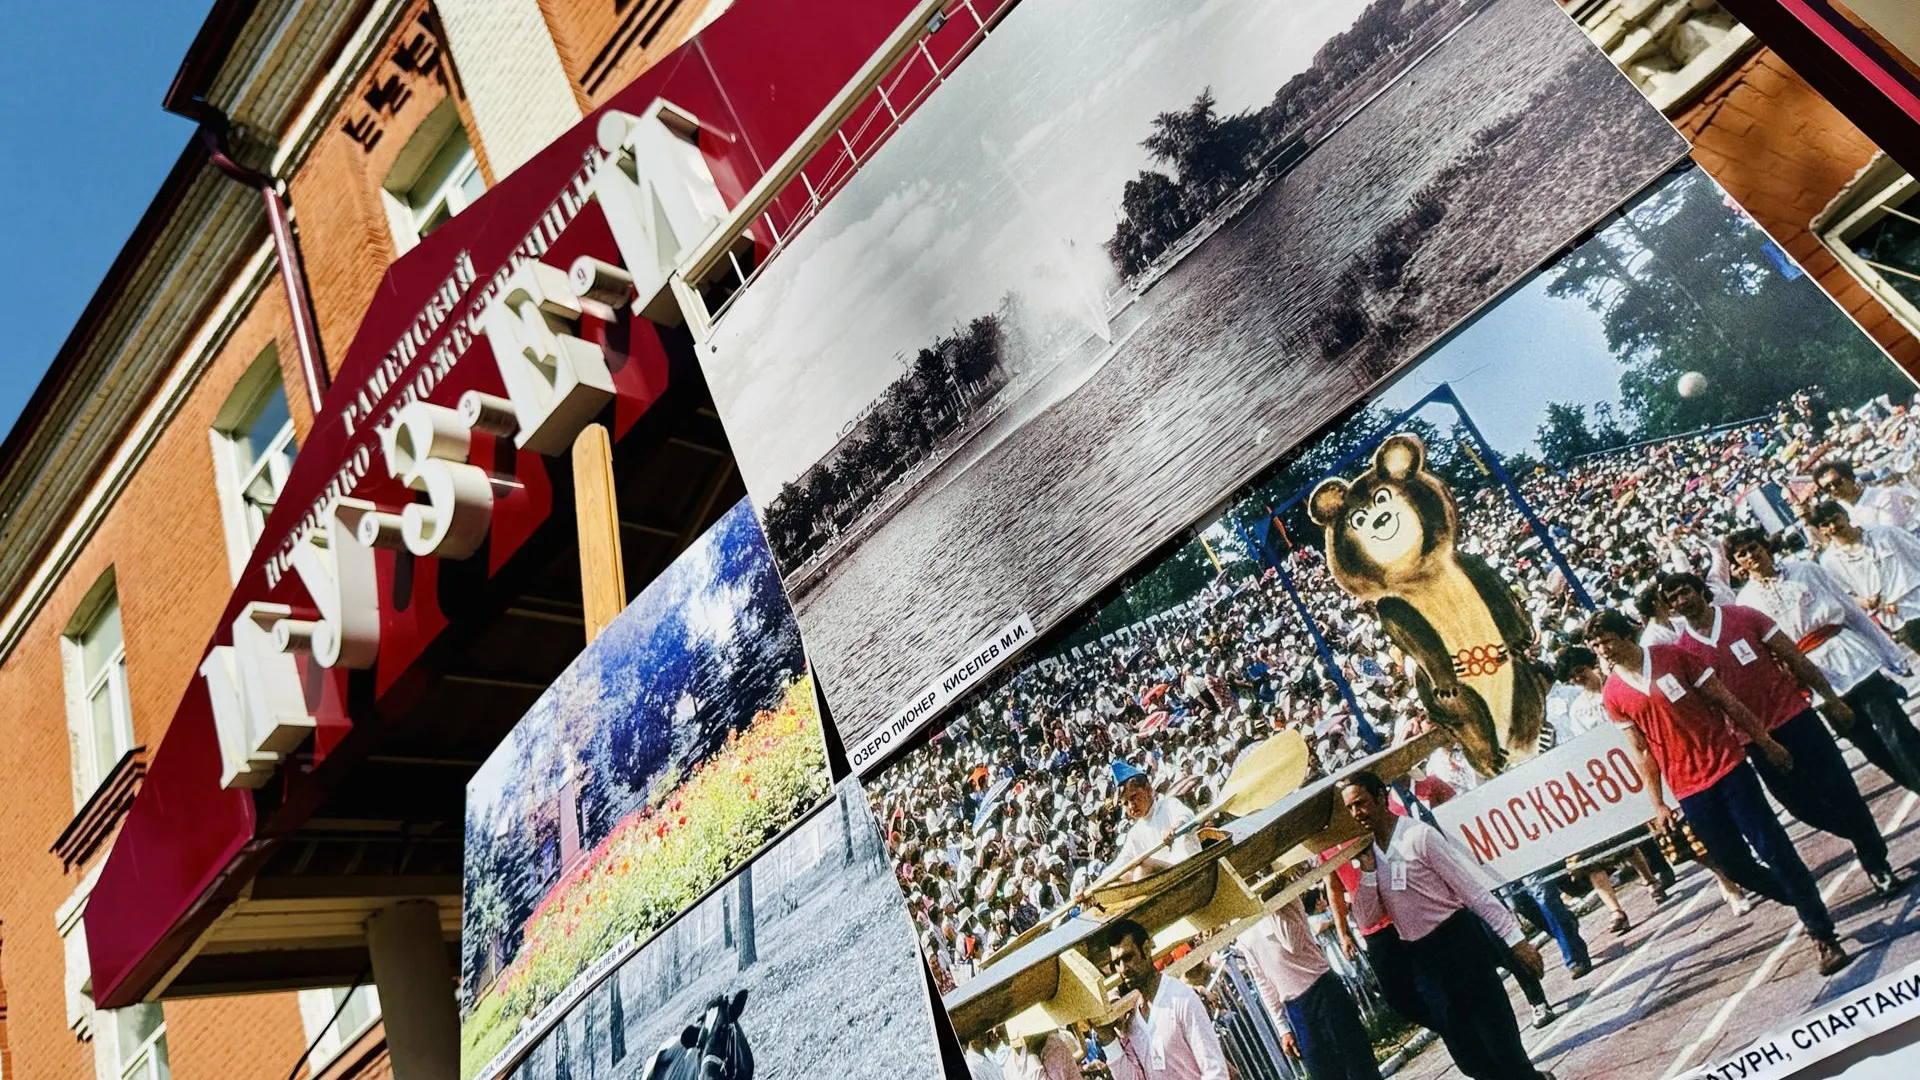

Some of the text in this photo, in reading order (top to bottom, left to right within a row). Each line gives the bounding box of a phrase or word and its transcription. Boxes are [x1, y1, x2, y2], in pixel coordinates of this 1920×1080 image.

[341, 248, 478, 437] РАМЕНСКИЙ
[199, 96, 730, 791] МУЗЕЙ
[852, 731, 891, 767] ОЗЕРО
[891, 691, 937, 737] ПИОНЕР
[942, 645, 1000, 694] КИСЕЛЕВ
[1000, 624, 1029, 650] М.И.
[1459, 747, 1644, 866] МОСКВА-80
[586, 951, 617, 983] КИСЕЛЕВ
